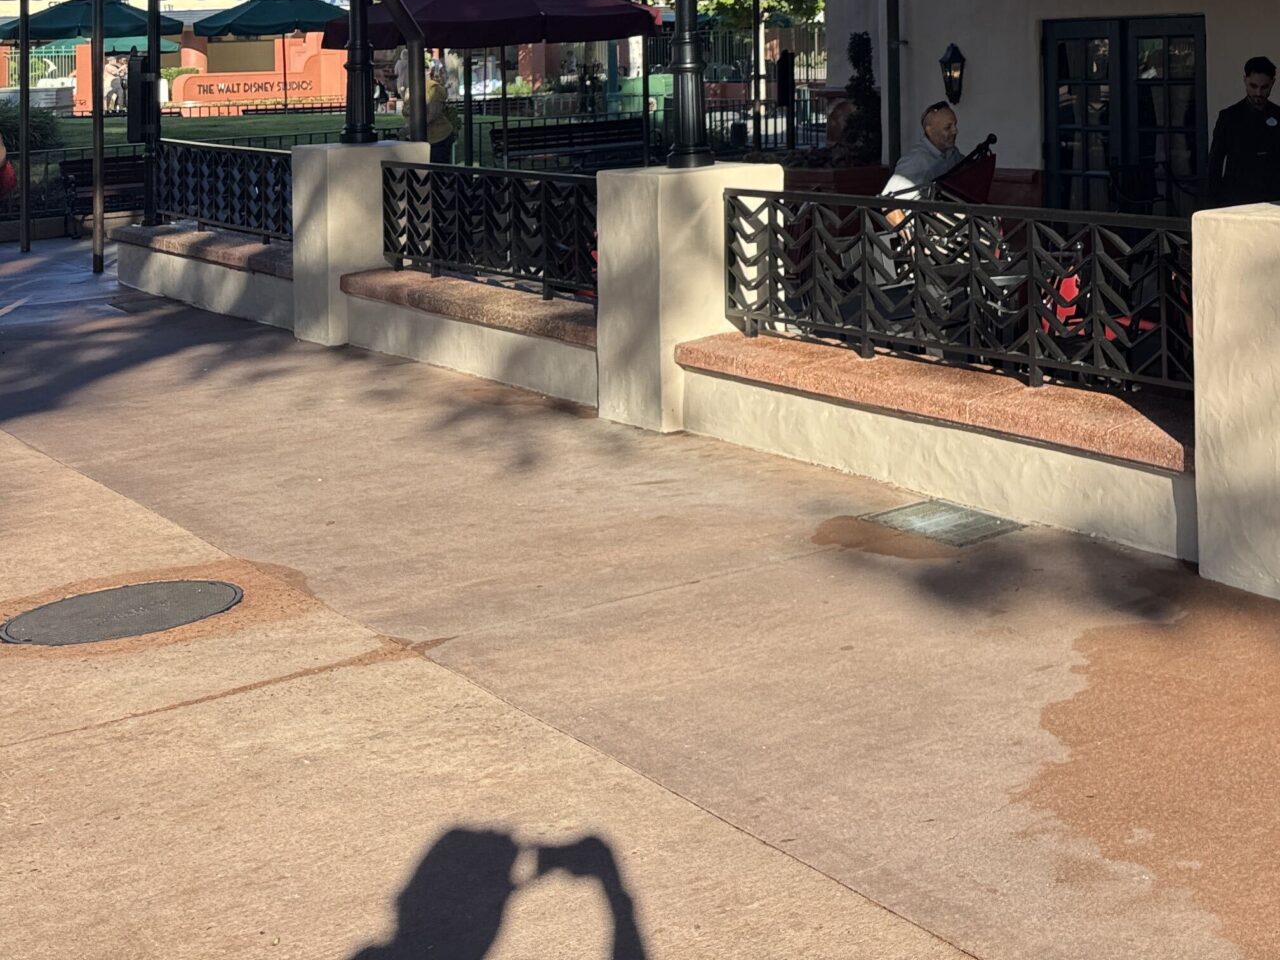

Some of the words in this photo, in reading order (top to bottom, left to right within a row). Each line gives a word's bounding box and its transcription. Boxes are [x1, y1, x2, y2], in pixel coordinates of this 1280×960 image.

[197, 84, 215, 95] THE
[216, 83, 242, 94] WALT
[243, 81, 275, 93] DISNEY
